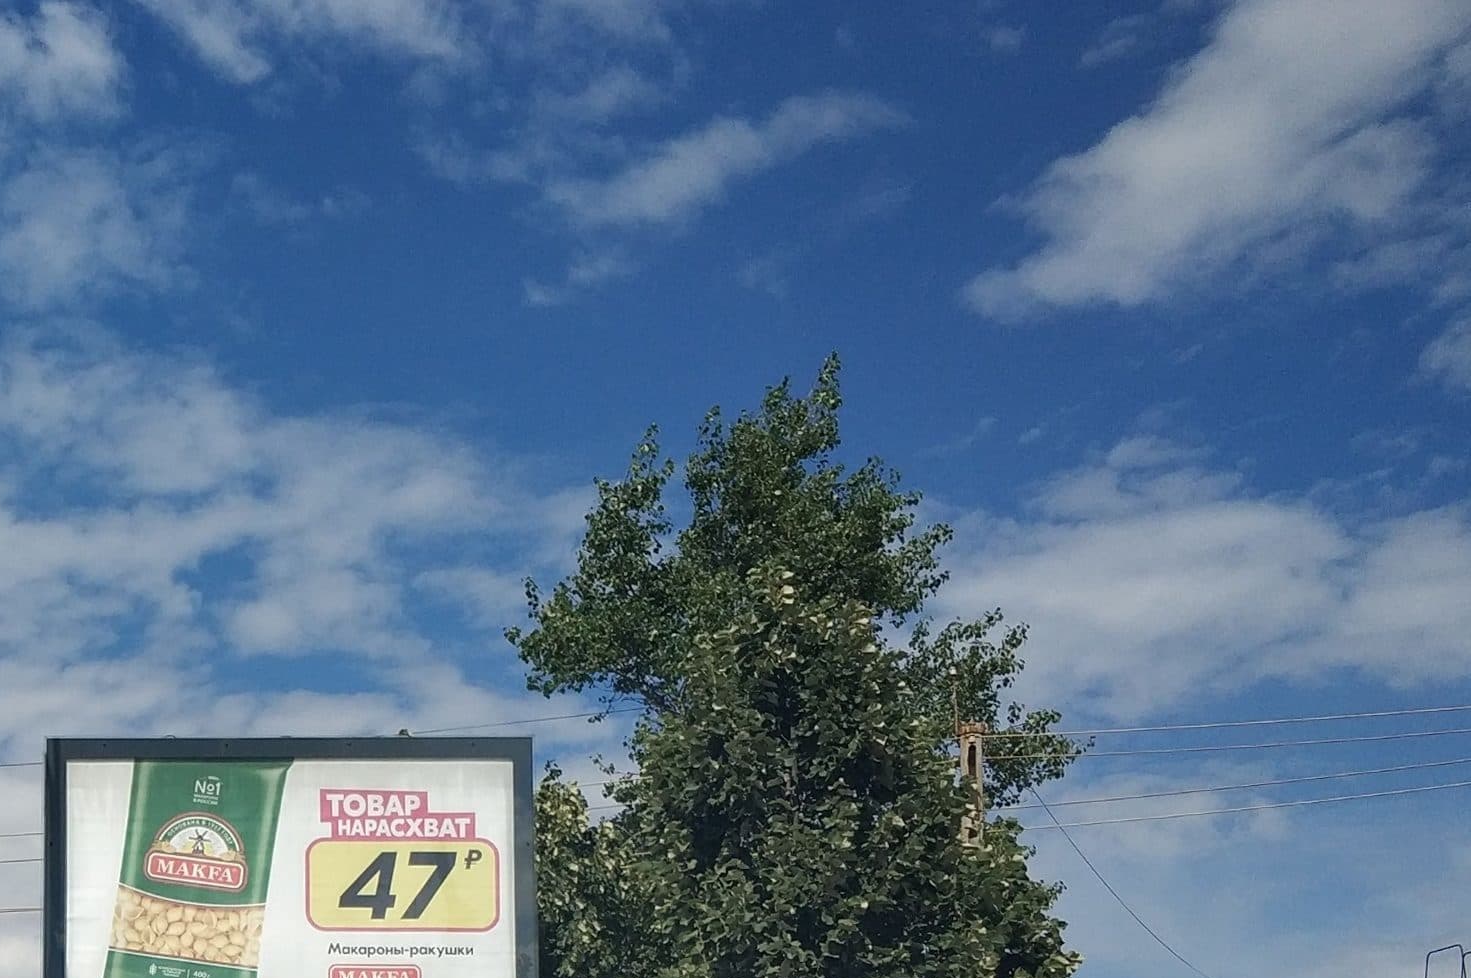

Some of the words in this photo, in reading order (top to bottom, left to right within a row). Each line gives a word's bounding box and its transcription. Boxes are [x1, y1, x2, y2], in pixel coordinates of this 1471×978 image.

[326, 793, 421, 817] ТОВАР
[337, 817, 471, 838] НАРАСХВАТ
[156, 858, 234, 884] MAKFA
[338, 851, 458, 920] 47
[328, 942, 474, 958] Макароны-ракушки
